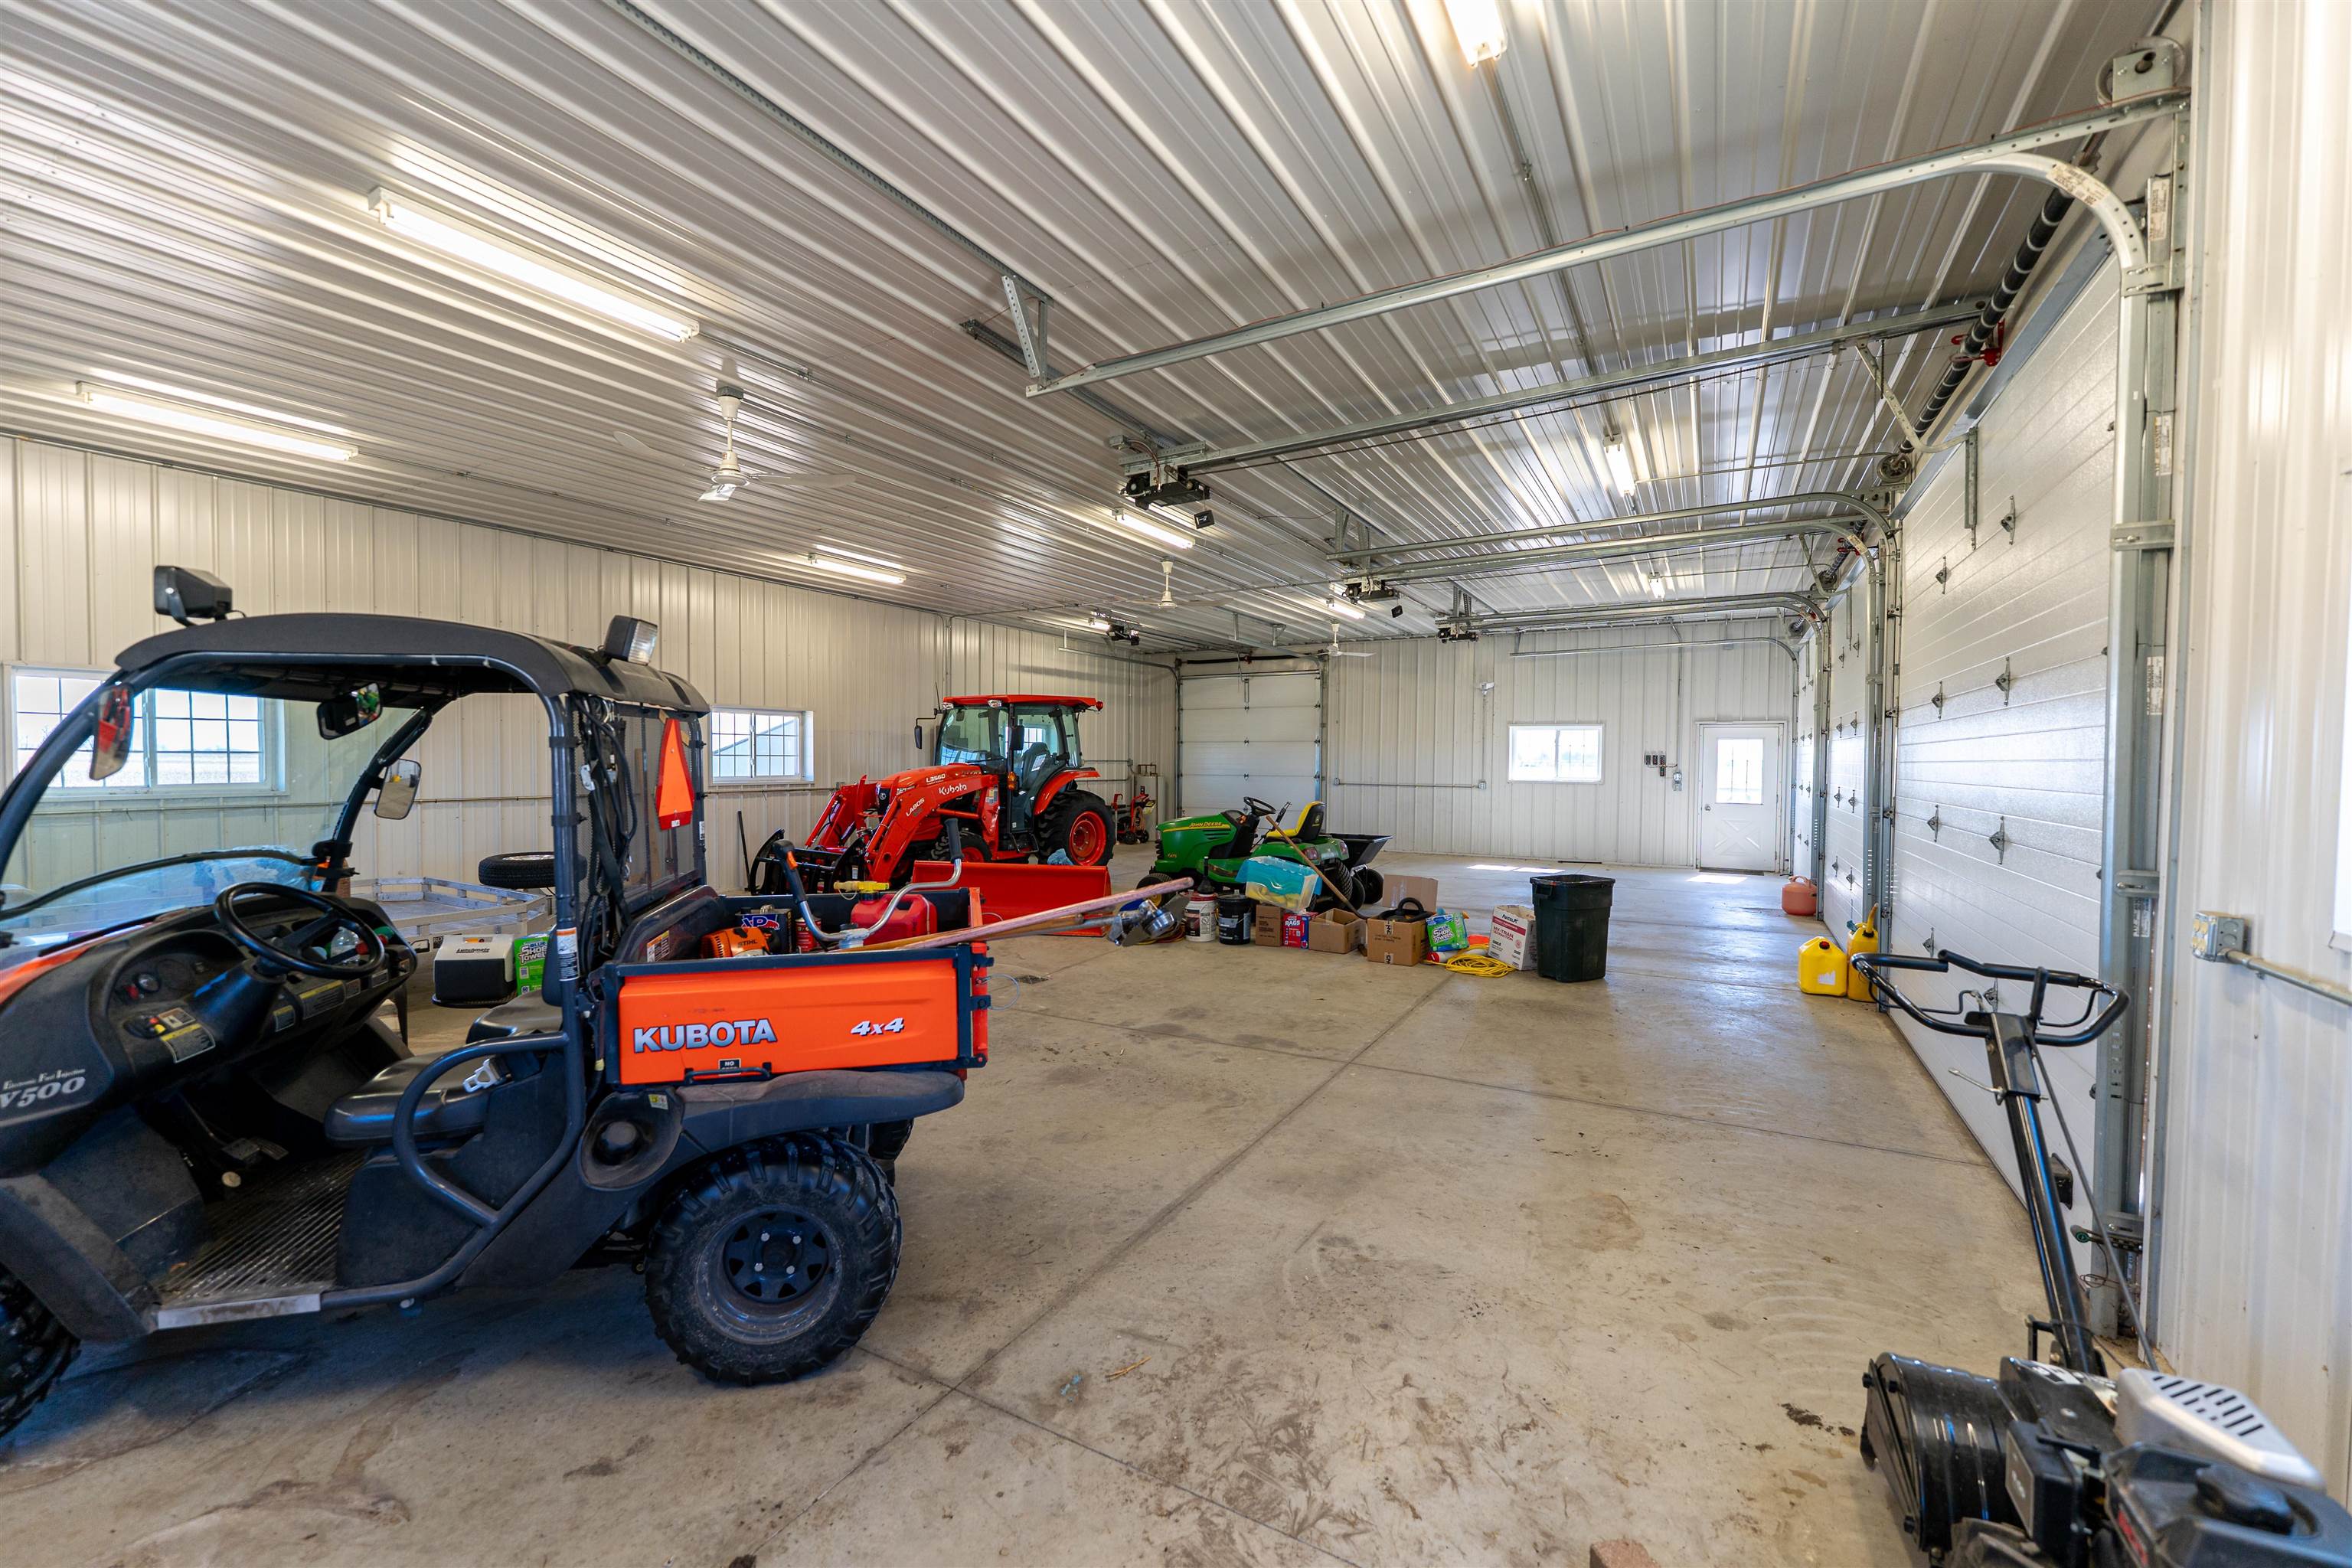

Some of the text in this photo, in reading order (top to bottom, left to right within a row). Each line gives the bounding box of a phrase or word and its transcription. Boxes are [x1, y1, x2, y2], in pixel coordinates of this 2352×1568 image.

[939, 783, 967, 795] Kubota
[906, 797, 926, 816] LA805
[737, 939, 758, 947] STIHL
[519, 951, 547, 963] TOWEL
[850, 1017, 905, 1037] 4x4
[633, 1018, 778, 1054] KUBOTA
